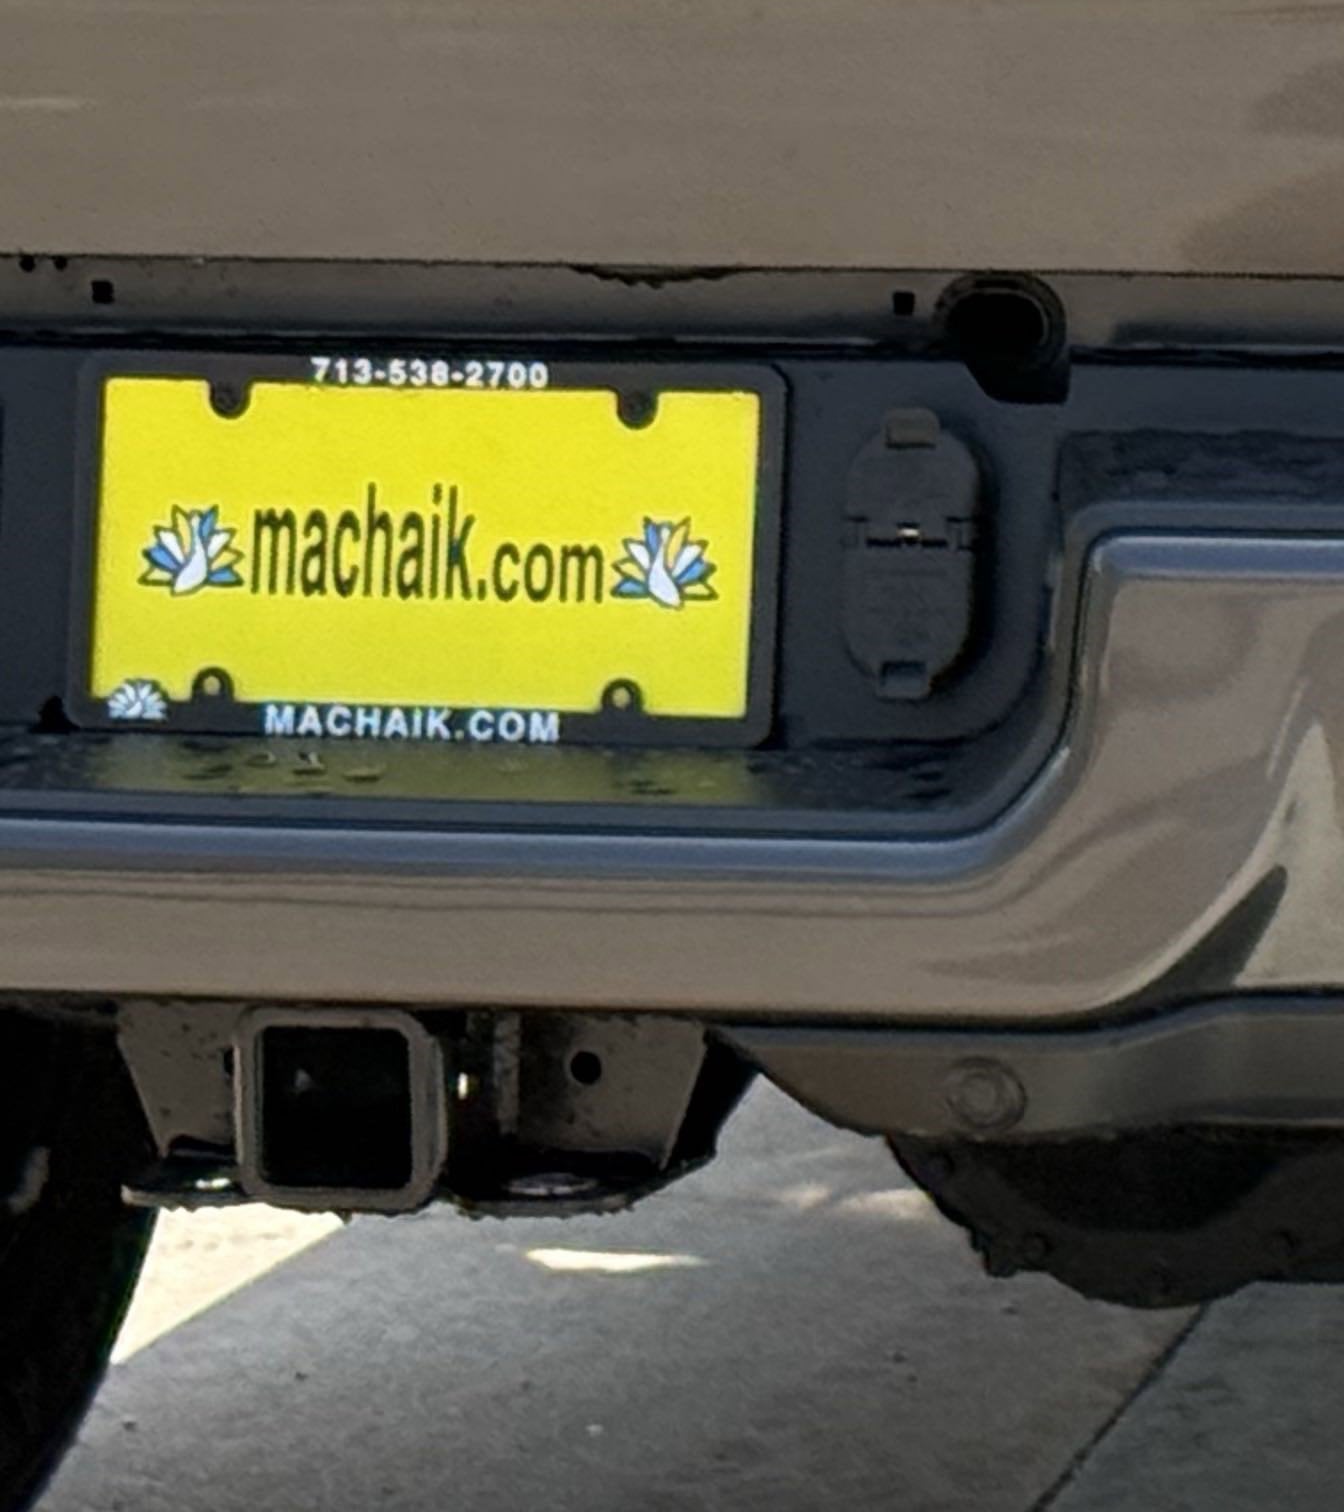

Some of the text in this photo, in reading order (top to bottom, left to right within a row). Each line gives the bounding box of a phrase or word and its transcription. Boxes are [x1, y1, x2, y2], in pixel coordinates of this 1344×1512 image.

[310, 356, 549, 388] 713-538-2700
[250, 481, 605, 604] machaik.com
[263, 702, 561, 743] MACHAIK.COM
